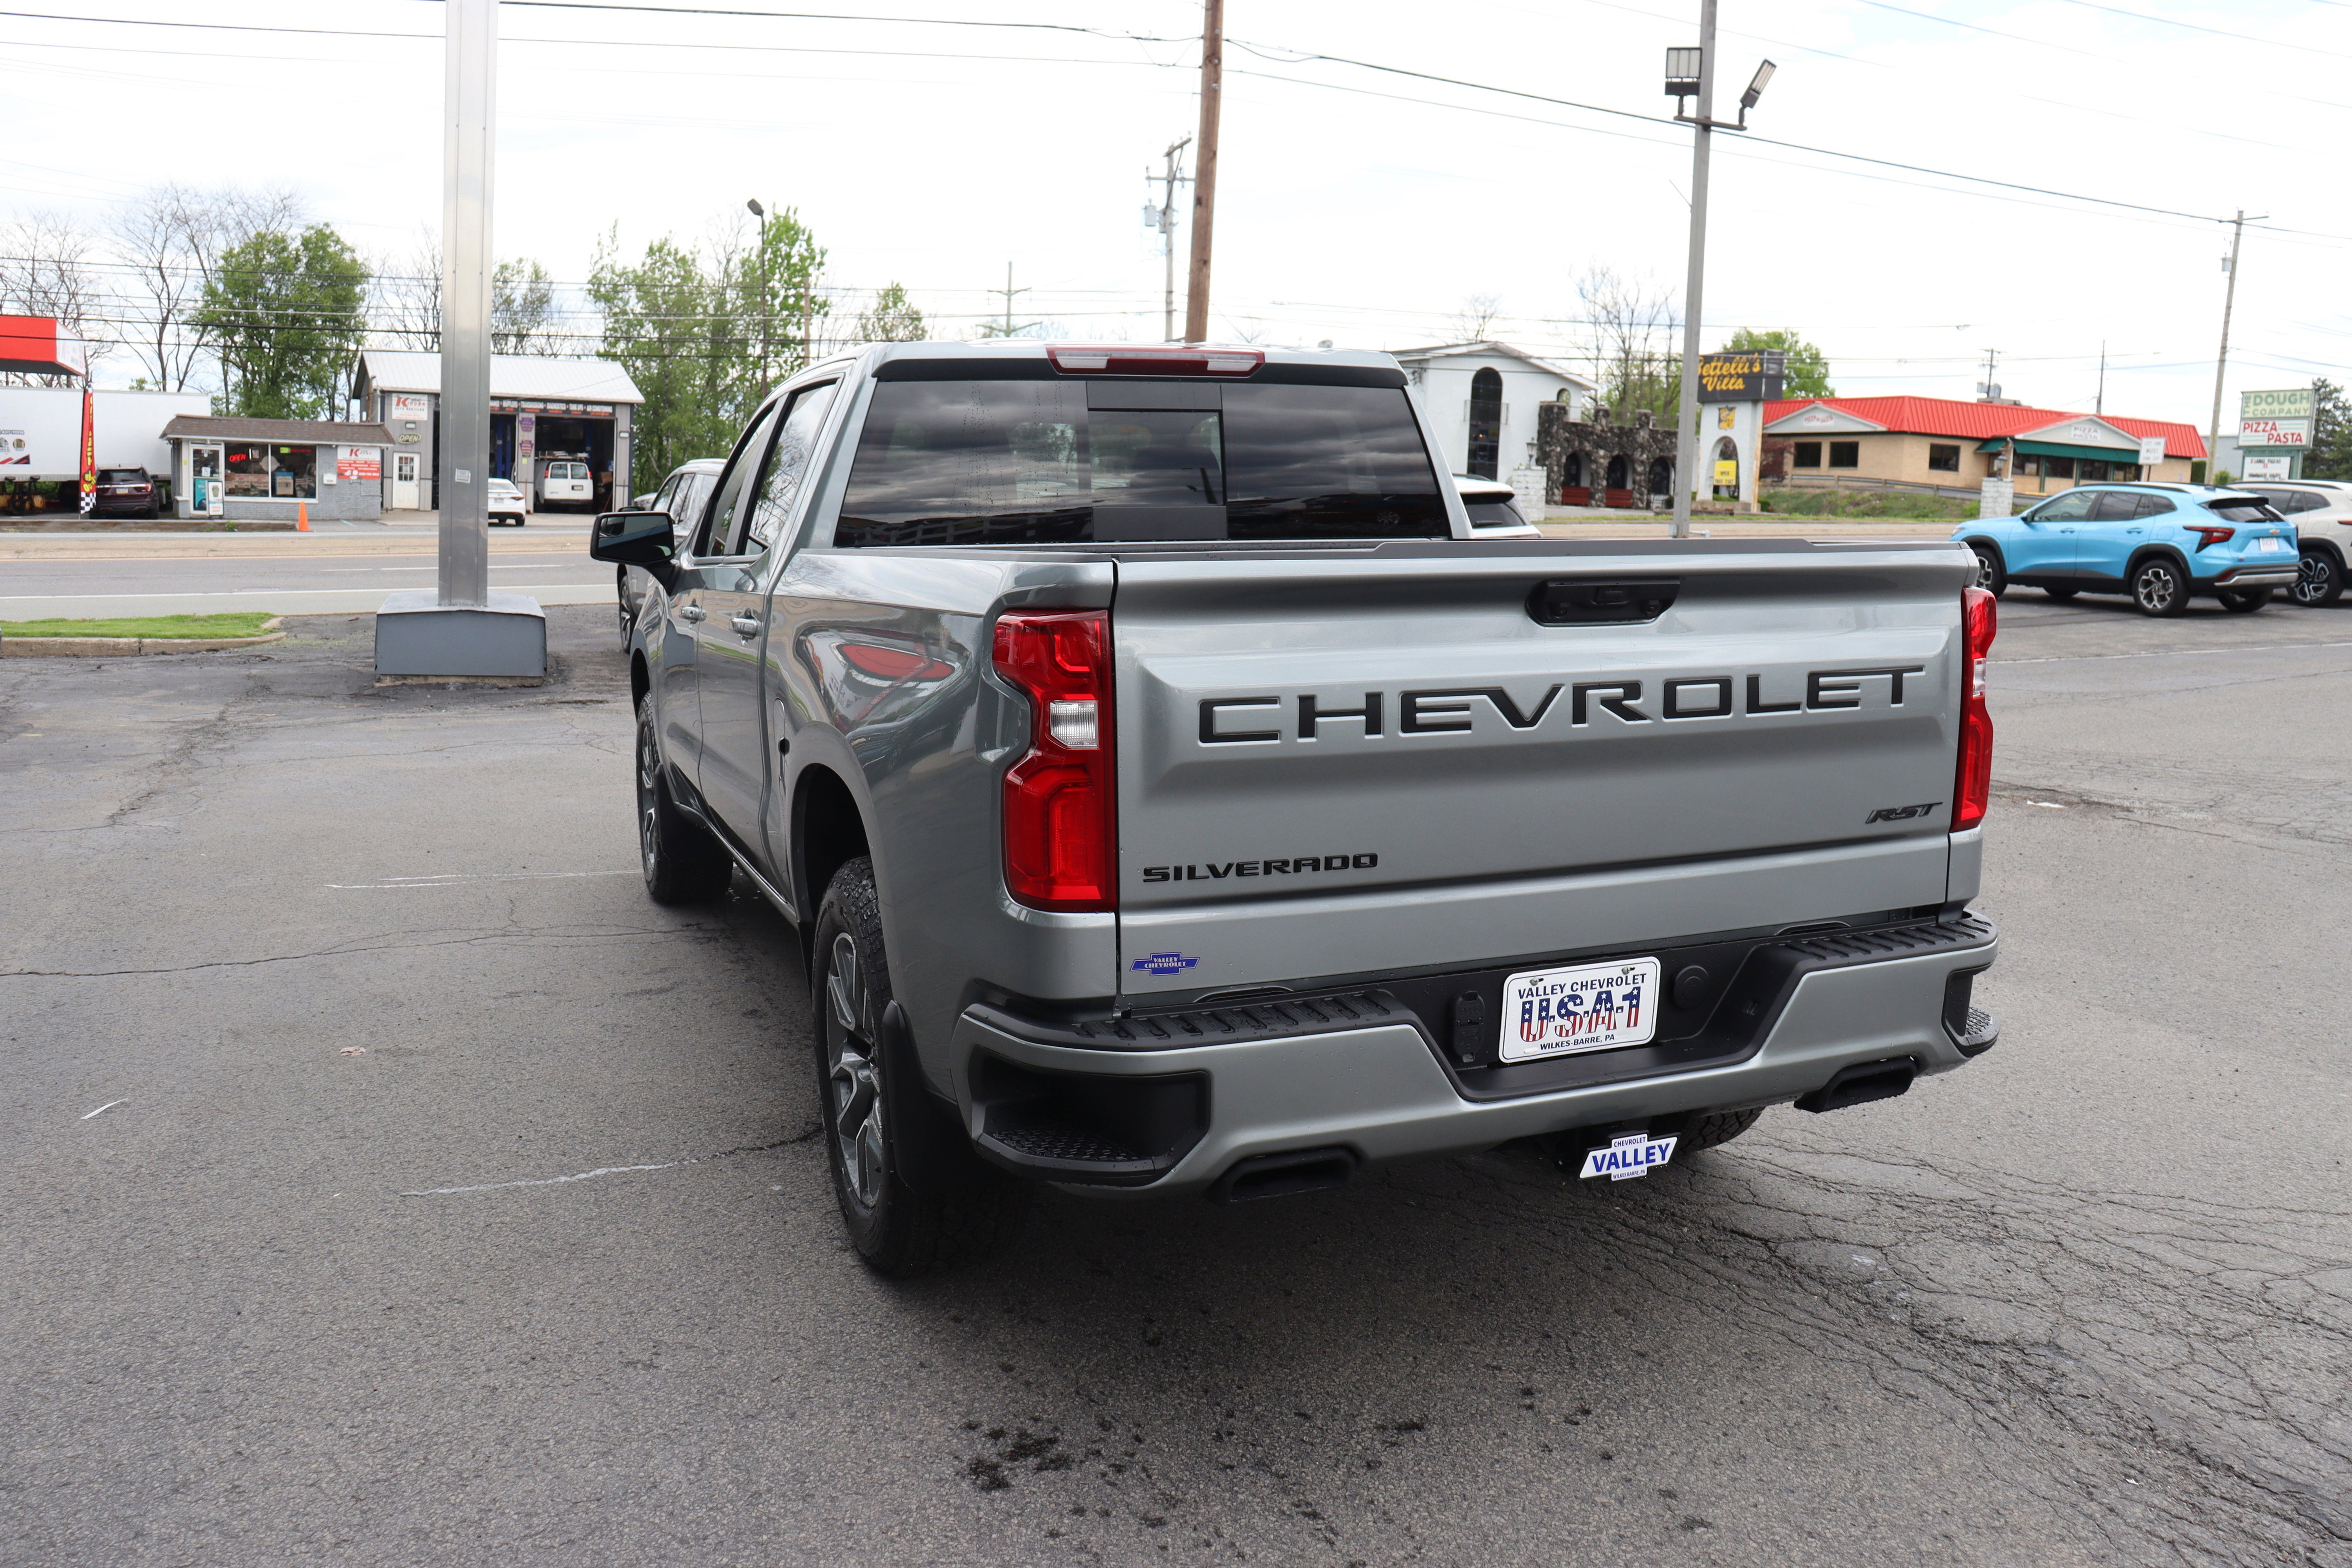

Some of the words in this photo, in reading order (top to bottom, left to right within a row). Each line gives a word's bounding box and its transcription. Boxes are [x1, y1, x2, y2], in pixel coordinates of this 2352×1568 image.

[1702, 374, 1746, 392] Villa
[2243, 395, 2251, 416] THE
[2253, 393, 2310, 406] DOUGH
[2252, 407, 2310, 416] COMPANY
[2243, 421, 2278, 433] PIZZA
[399, 434, 419, 442] OPEN
[2267, 432, 2303, 444] PASTA
[229, 454, 247, 462] OPEN
[1198, 666, 1924, 744] CHEVROLET
[1864, 802, 1943, 824] RST
[1143, 852, 1378, 882] SILVERADO
[1518, 983, 1566, 999] VALLEY
[1570, 973, 1647, 993] CHEVROLET
[1540, 1036, 1602, 1050] WILKES-BARRE,
[1614, 1137, 1646, 1147] CHEVROLET
[1592, 1143, 1670, 1173] VALLEY
